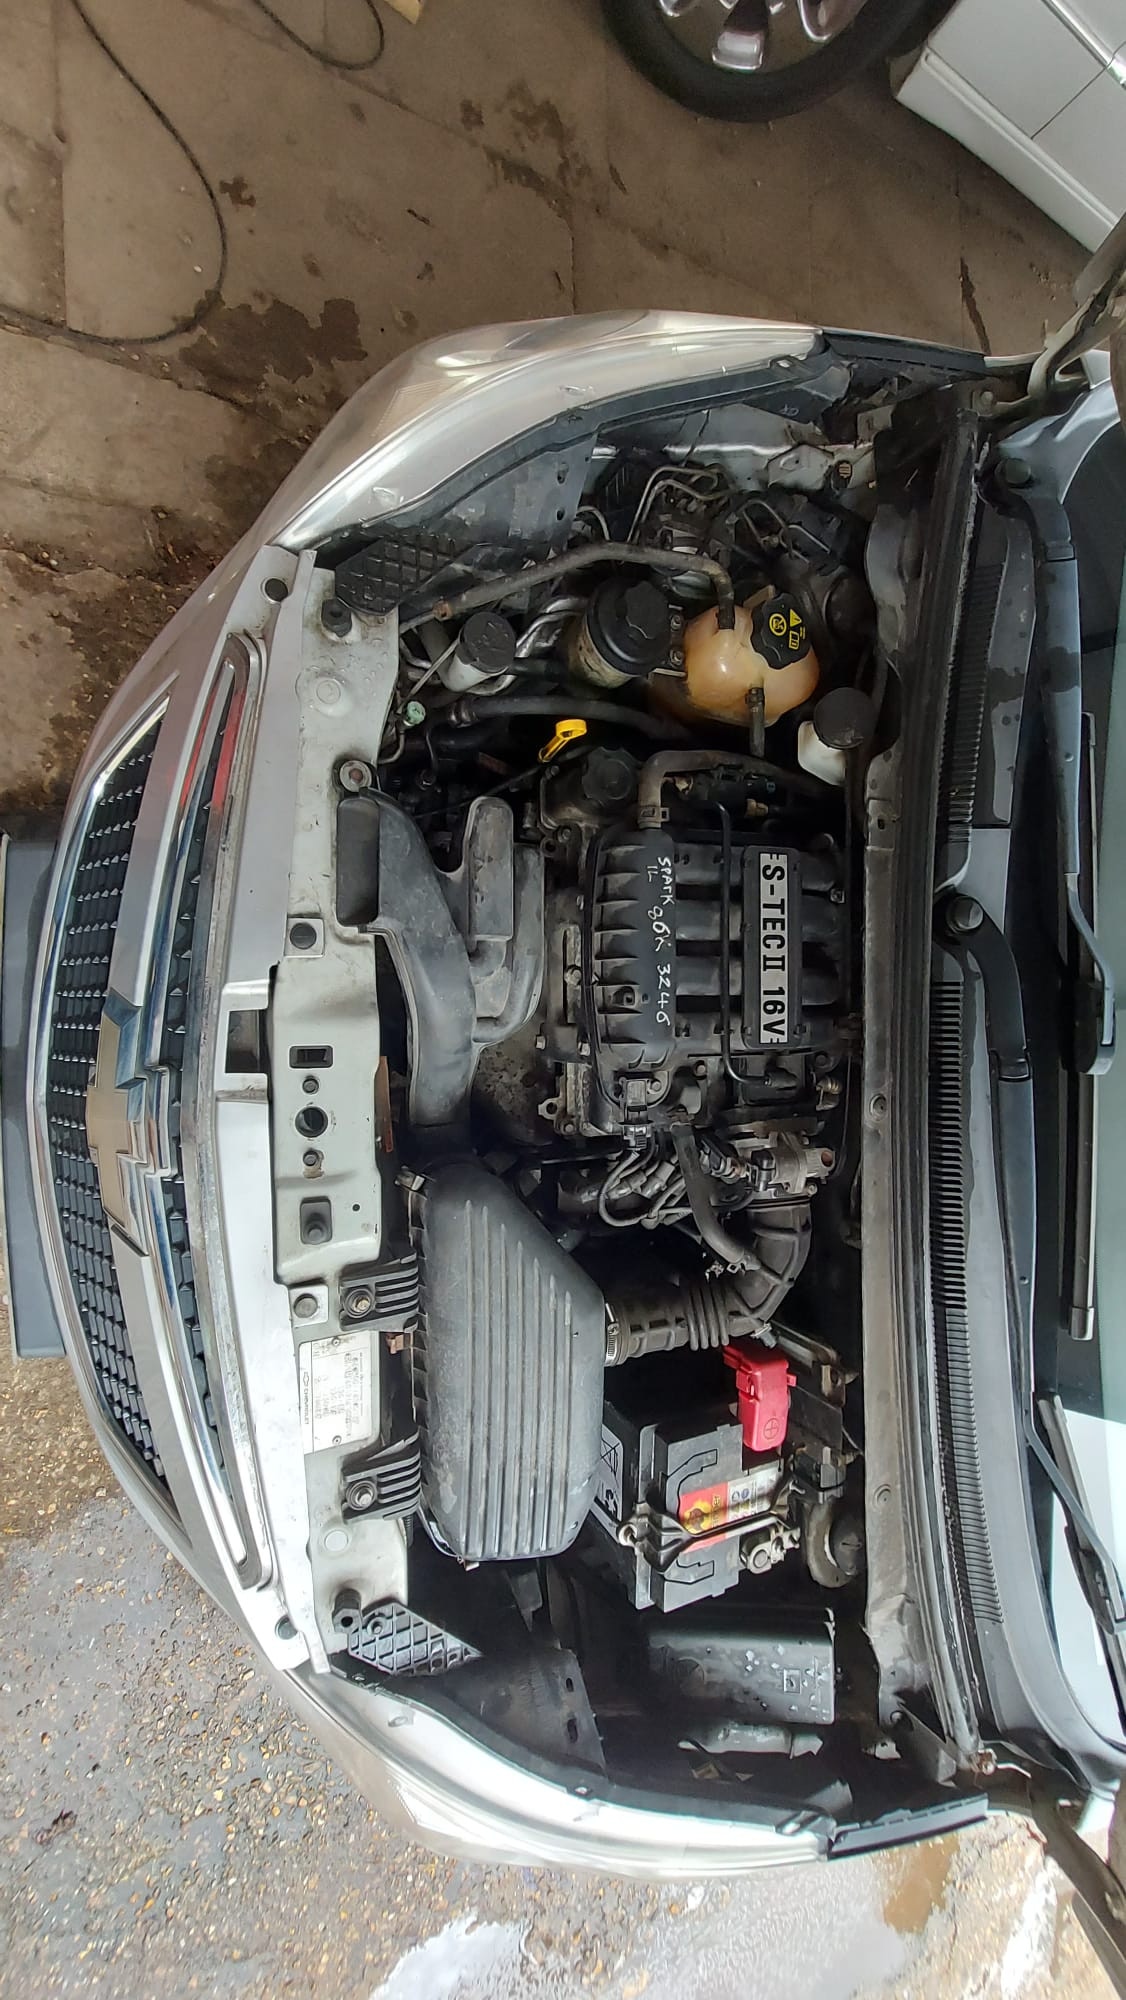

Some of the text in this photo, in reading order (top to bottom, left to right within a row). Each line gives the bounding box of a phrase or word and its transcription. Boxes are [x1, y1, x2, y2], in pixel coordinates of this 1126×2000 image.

[658, 856, 675, 905] SPARK
[656, 963, 671, 1027] 3246
[762, 986, 785, 1036] 16V
